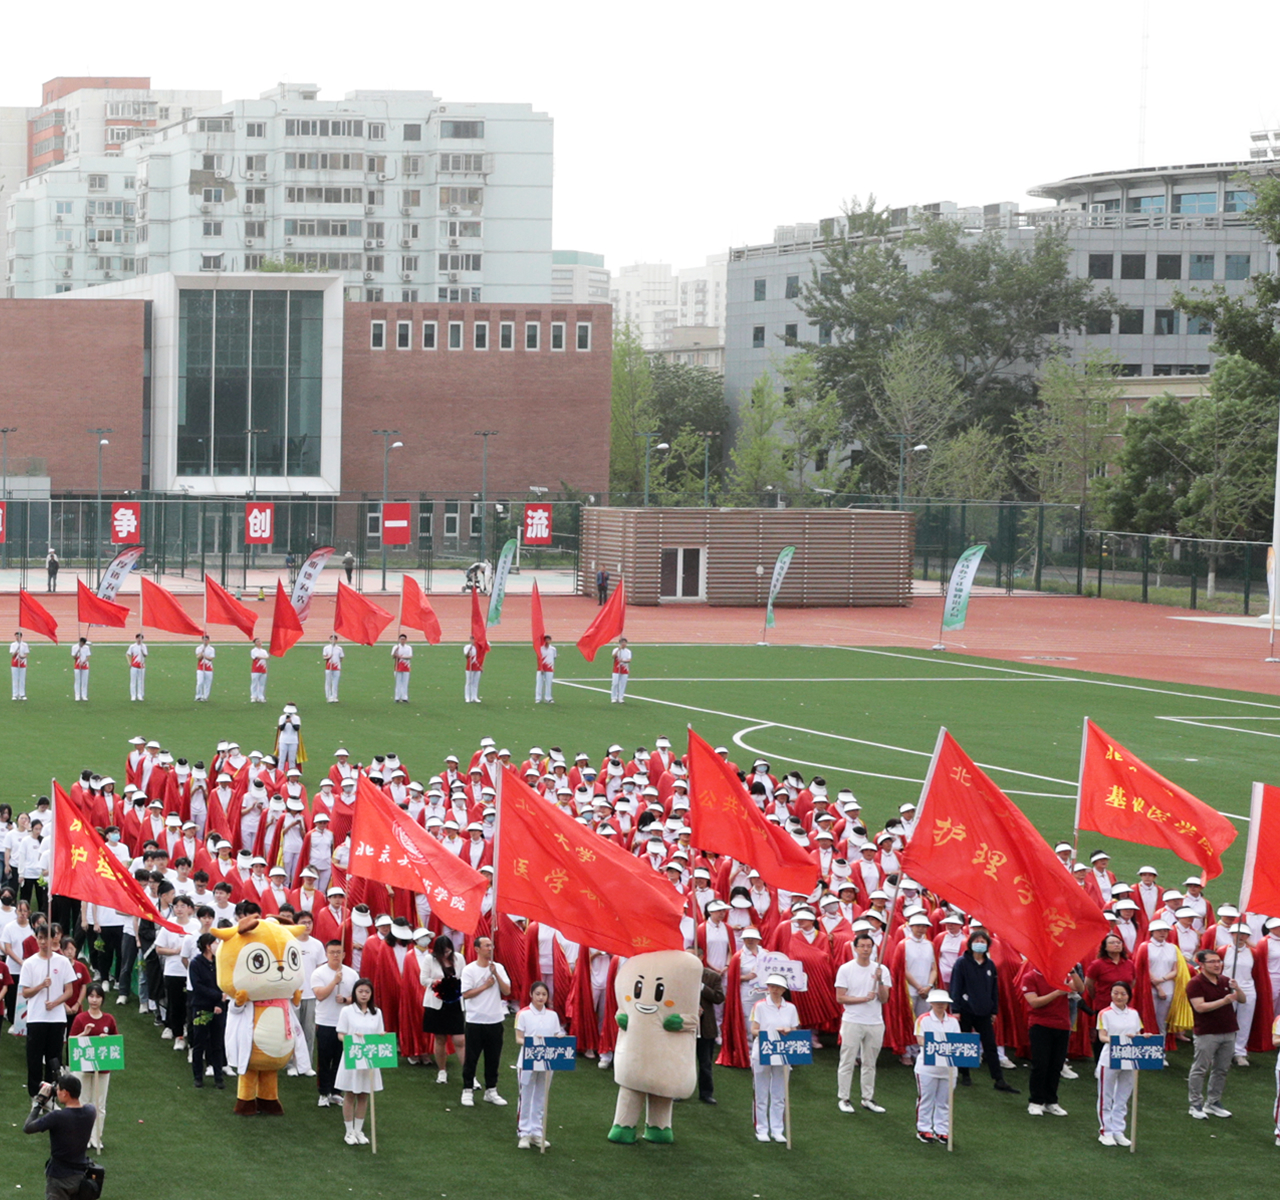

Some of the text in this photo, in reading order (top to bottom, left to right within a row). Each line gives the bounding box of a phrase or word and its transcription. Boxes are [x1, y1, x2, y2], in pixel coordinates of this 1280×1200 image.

[114, 508, 137, 537] 争
[249, 509, 271, 537] 创
[527, 509, 549, 538] 流
[72, 1046, 121, 1061] 护理学院
[348, 1043, 393, 1059] 药学院
[524, 1046, 575, 1060] 医学部产业
[760, 1040, 810, 1054] 公卫学院
[925, 1042, 978, 1058] 护理学院
[1111, 1045, 1164, 1060] 基础医学院
